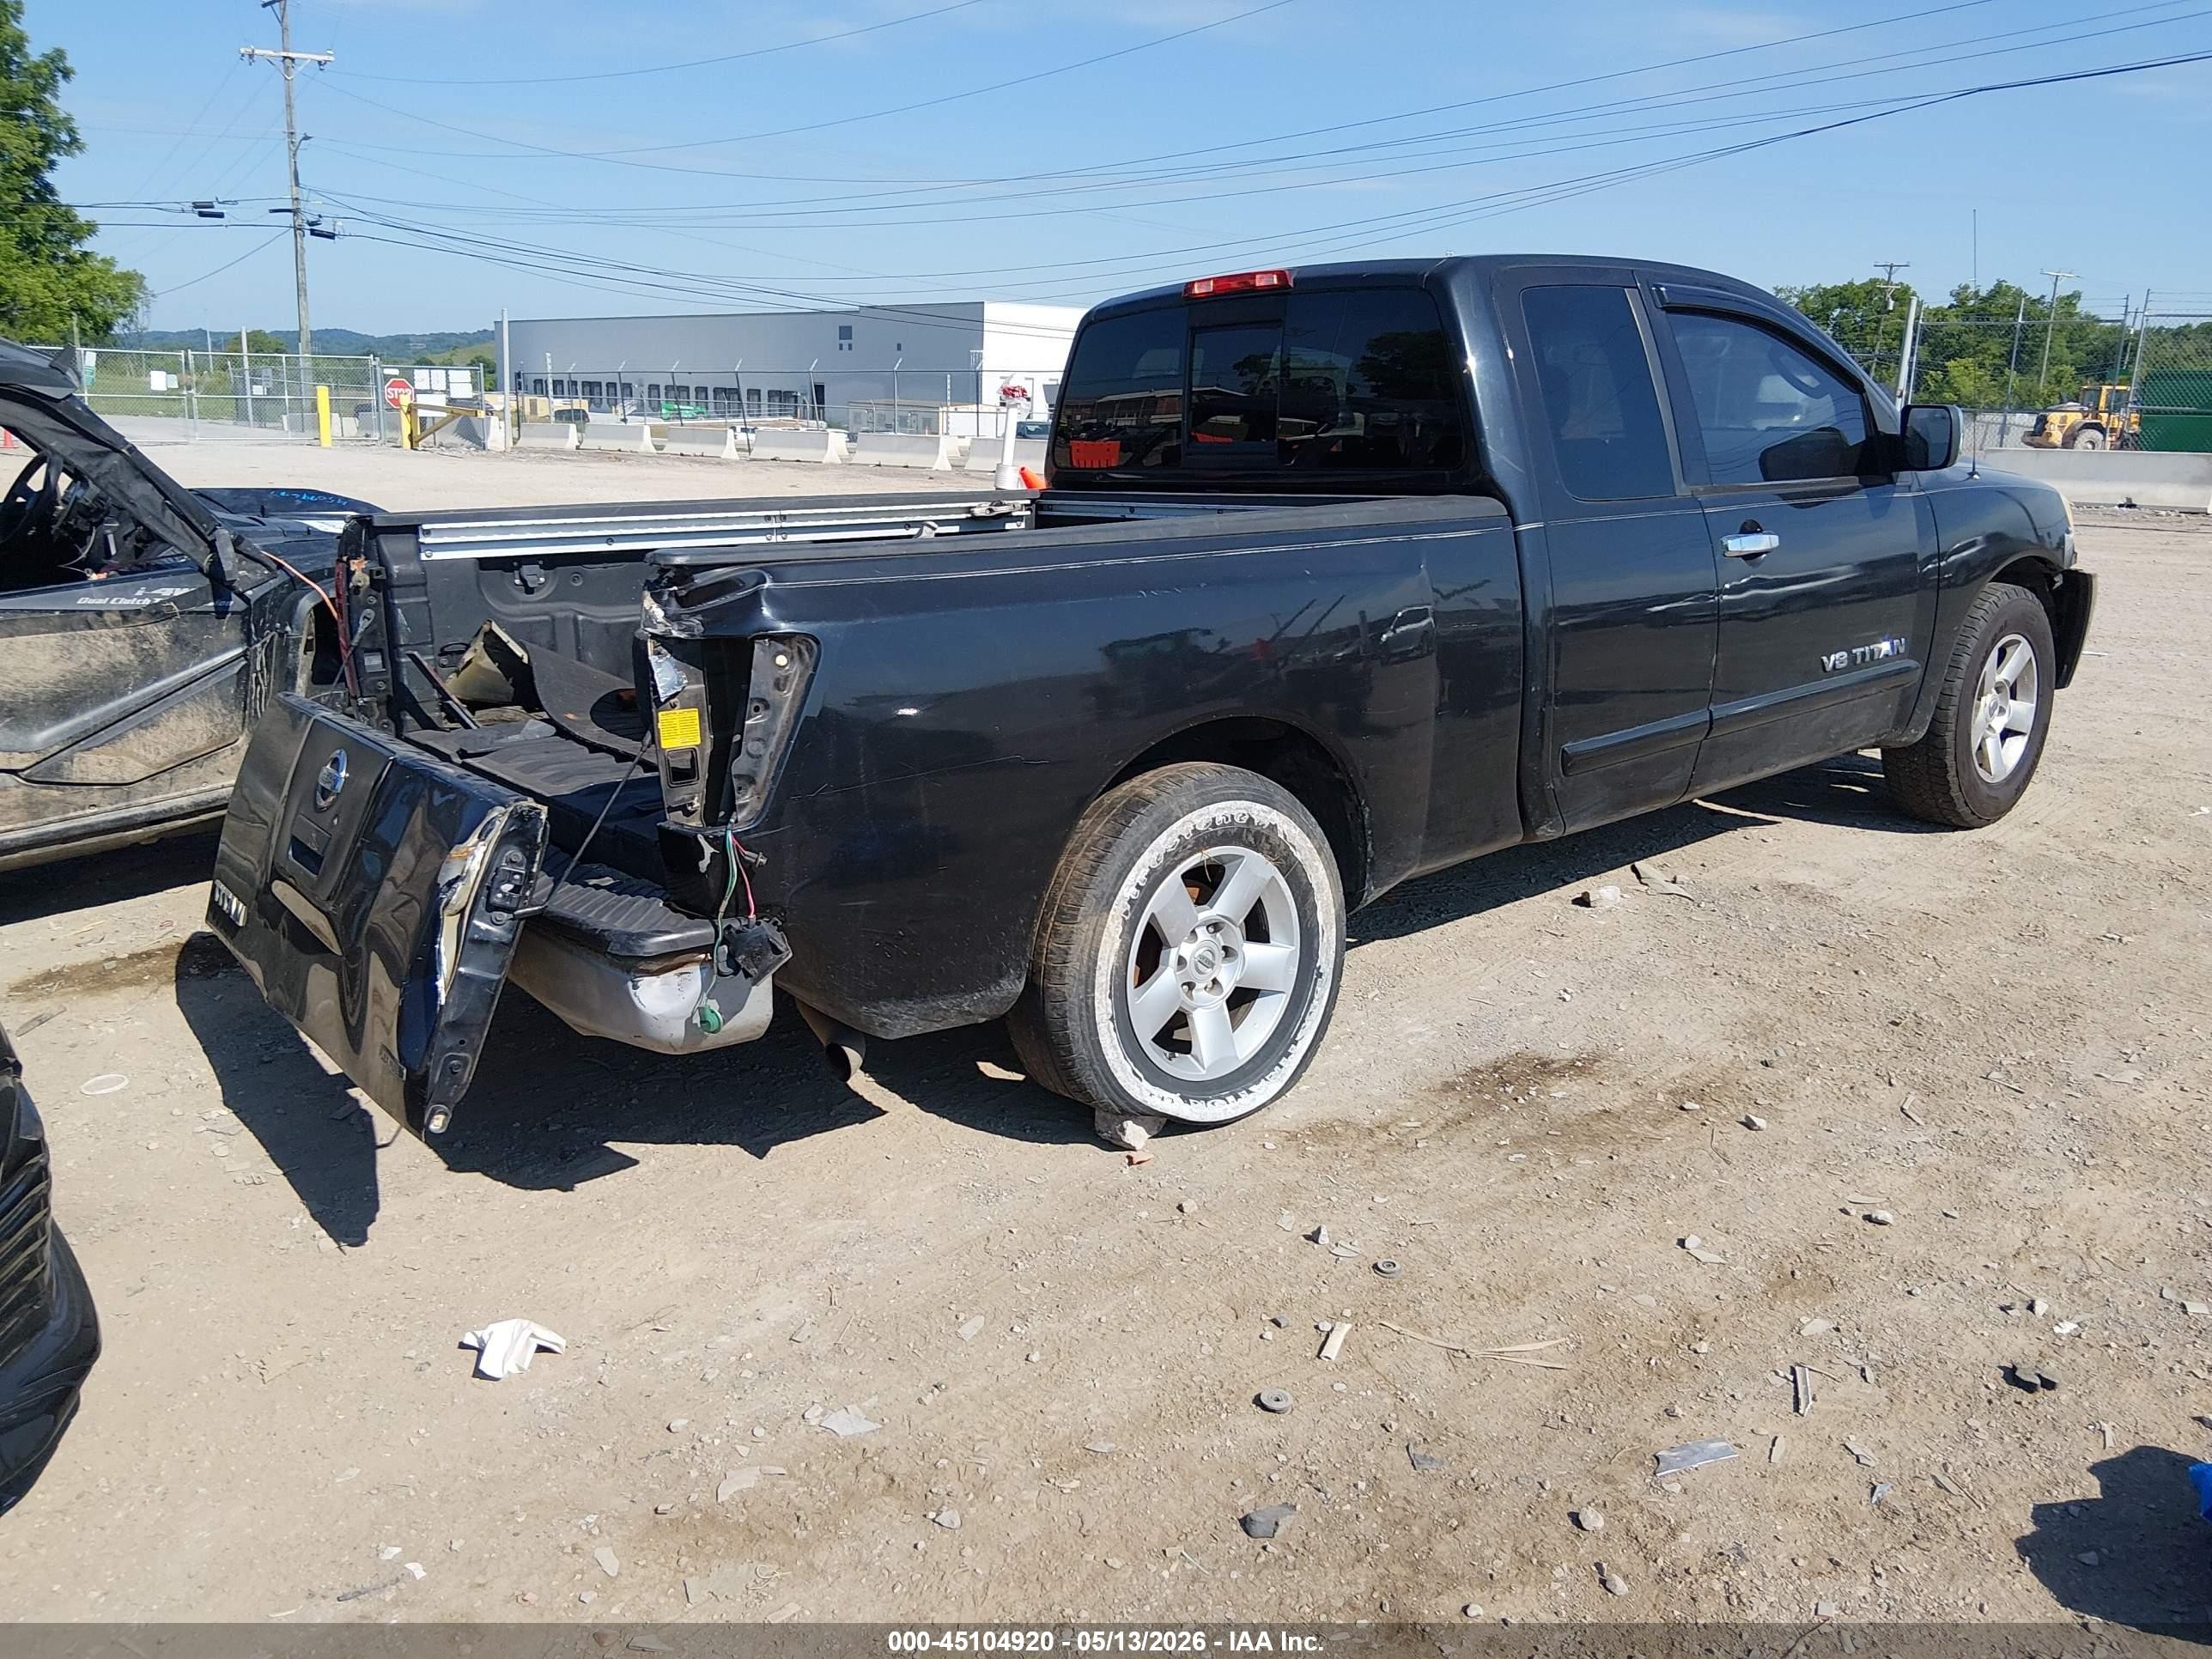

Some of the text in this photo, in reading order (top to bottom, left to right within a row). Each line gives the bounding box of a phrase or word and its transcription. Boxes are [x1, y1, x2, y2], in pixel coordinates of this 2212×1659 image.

[387, 387, 412, 399] STOP
[134, 586, 197, 596] i-4W
[1820, 637, 1905, 672] V8 TITAN
